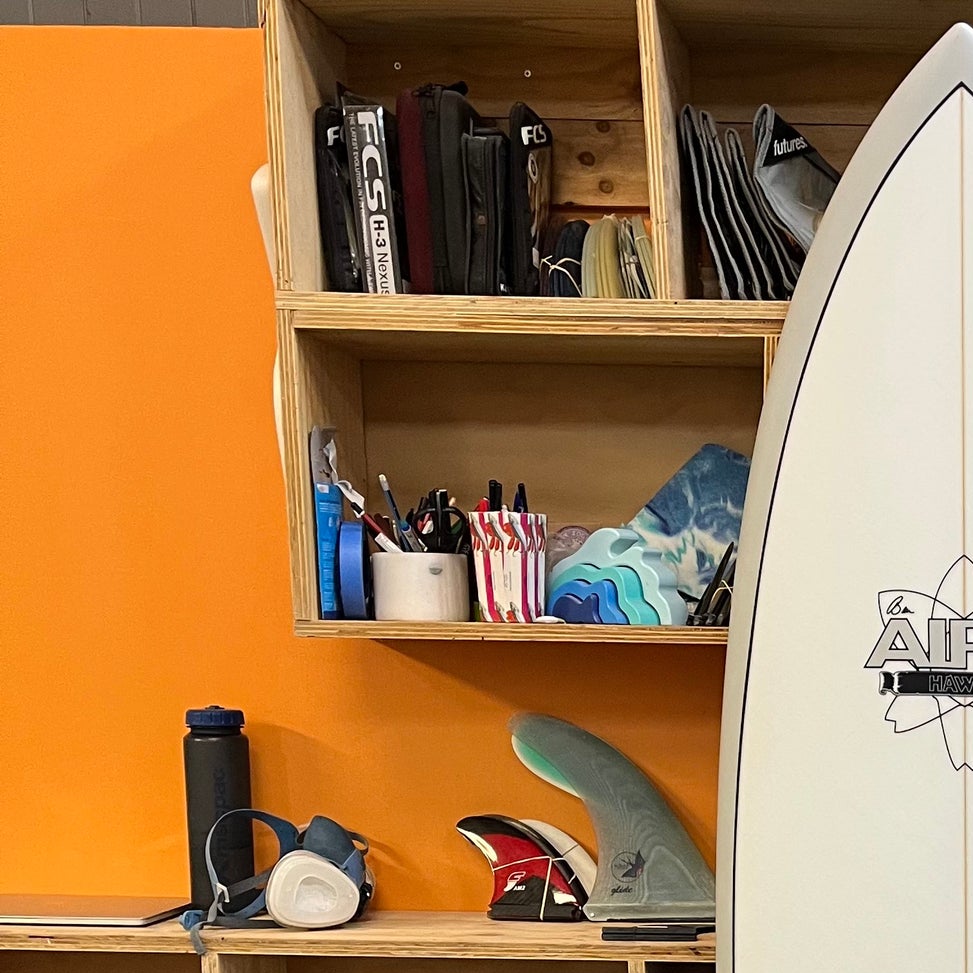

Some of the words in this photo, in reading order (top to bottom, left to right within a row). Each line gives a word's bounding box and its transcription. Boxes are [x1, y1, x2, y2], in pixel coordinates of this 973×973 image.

[520, 124, 547, 145] FCS
[357, 111, 387, 212] FCS
[373, 220, 387, 248] H-3
